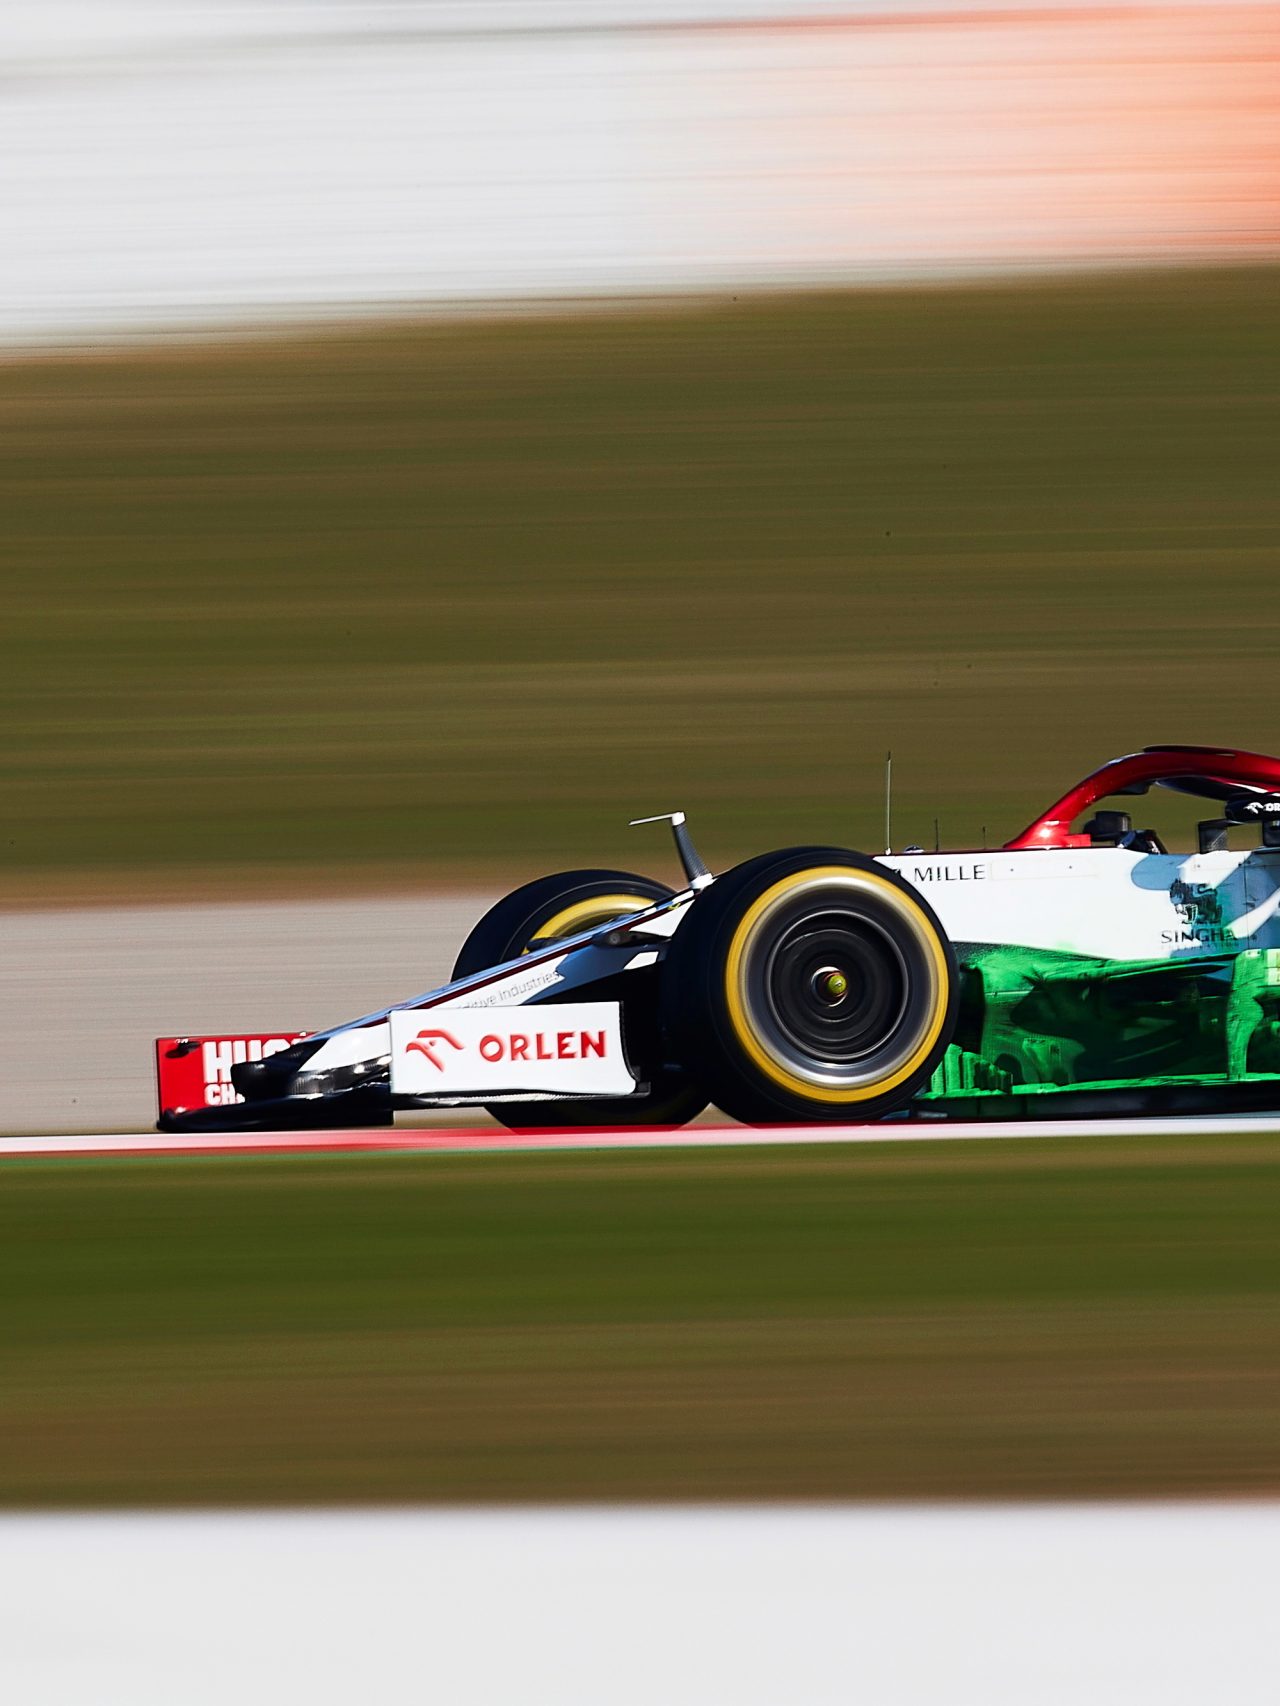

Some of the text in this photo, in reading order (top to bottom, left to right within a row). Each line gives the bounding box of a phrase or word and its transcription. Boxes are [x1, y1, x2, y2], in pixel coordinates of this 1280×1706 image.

[914, 864, 985, 882] MILLE
[1160, 928, 1239, 944] SINGHA
[479, 1030, 606, 1063] ORLEN
